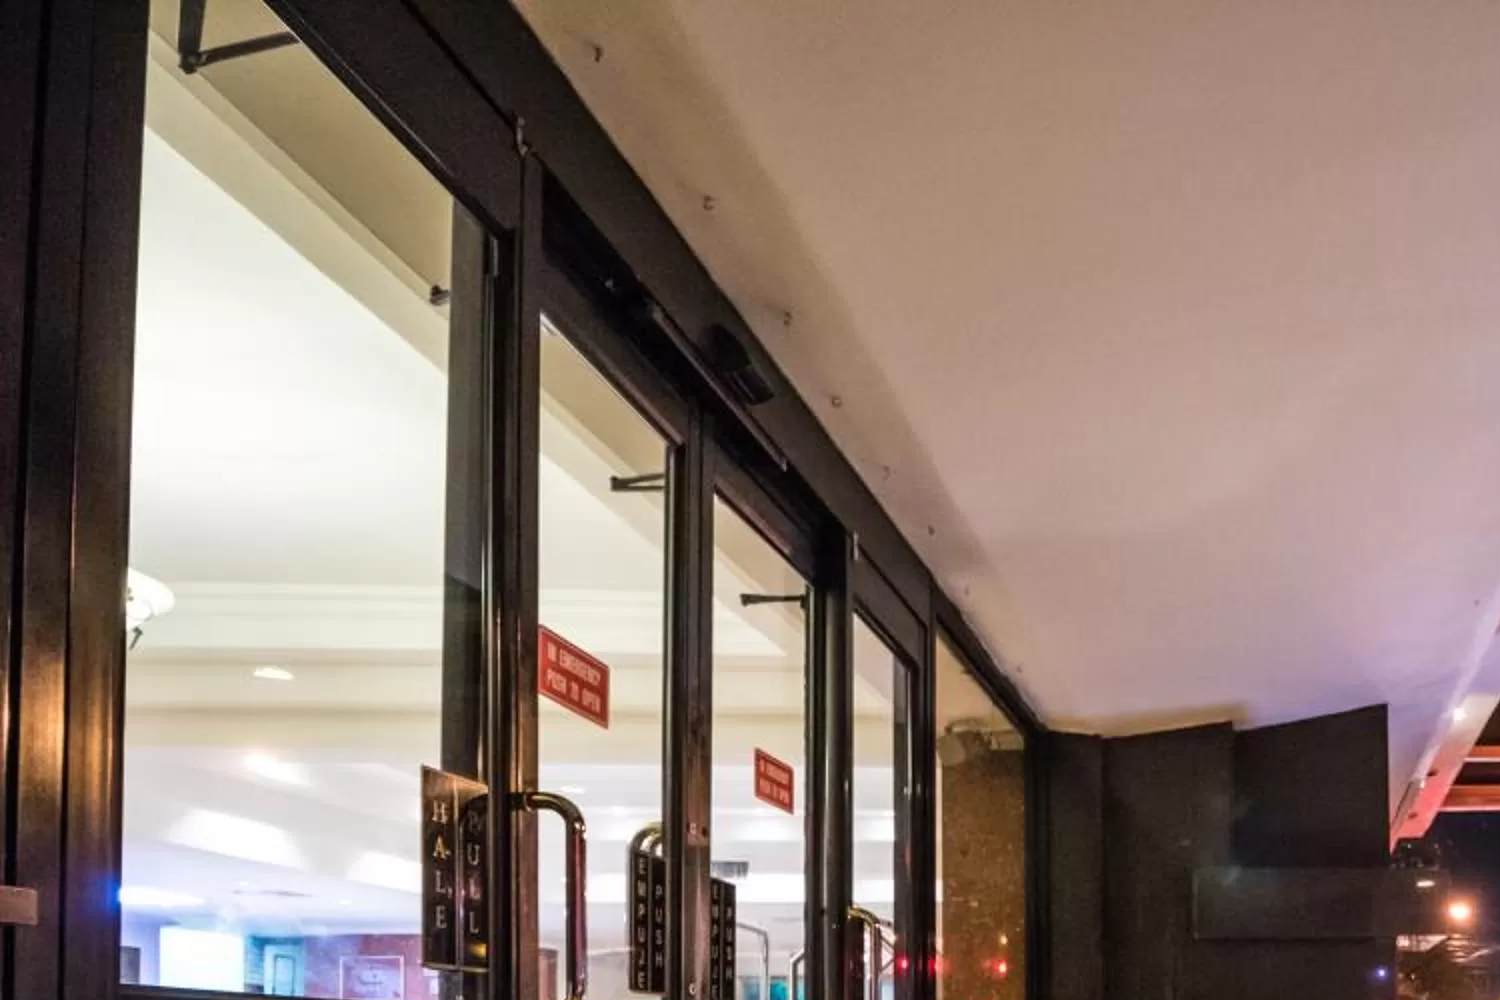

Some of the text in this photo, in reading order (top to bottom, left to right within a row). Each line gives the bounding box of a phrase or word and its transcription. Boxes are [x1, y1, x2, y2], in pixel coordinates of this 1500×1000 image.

[432, 800, 448, 930] HALE
[466, 809, 482, 935] PULL
[654, 883, 663, 968] PUSH
